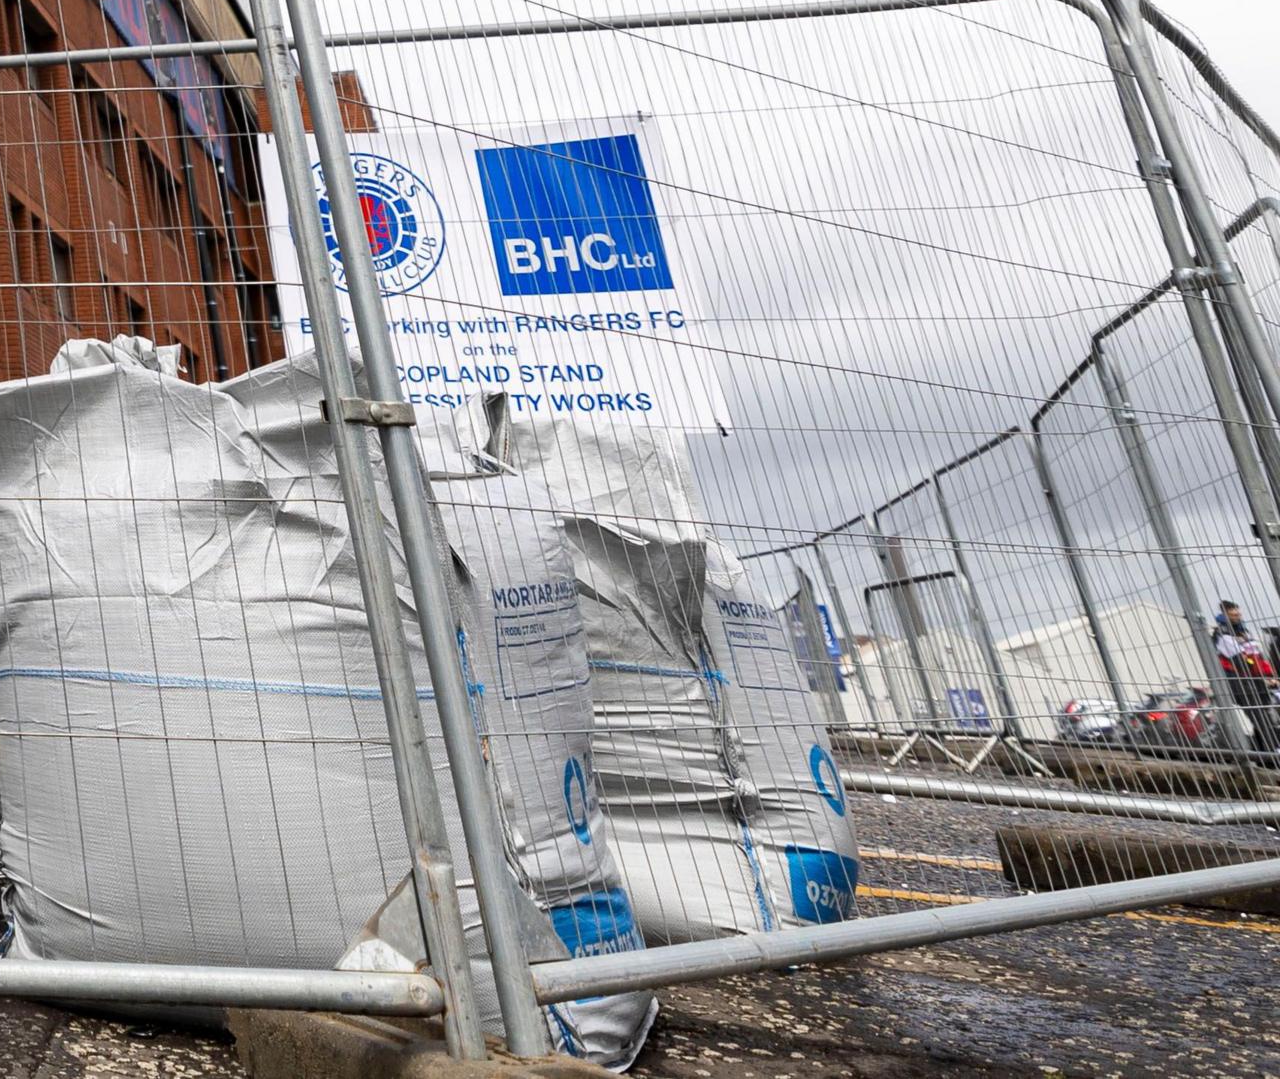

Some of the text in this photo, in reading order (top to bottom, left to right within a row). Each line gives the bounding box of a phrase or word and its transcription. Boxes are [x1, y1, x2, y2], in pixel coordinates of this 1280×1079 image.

[403, 235, 437, 280] CLUB
[504, 232, 656, 274] BHC Ltd
[385, 317, 451, 339] rking
[457, 316, 508, 334] with
[515, 311, 641, 333] RANGERS
[648, 310, 685, 329] FC
[462, 343, 518, 357] on the
[519, 363, 605, 383] STAND
[550, 392, 653, 412] WORKS
[491, 583, 554, 609] MORTAR
[716, 599, 770, 621] MORTAR
